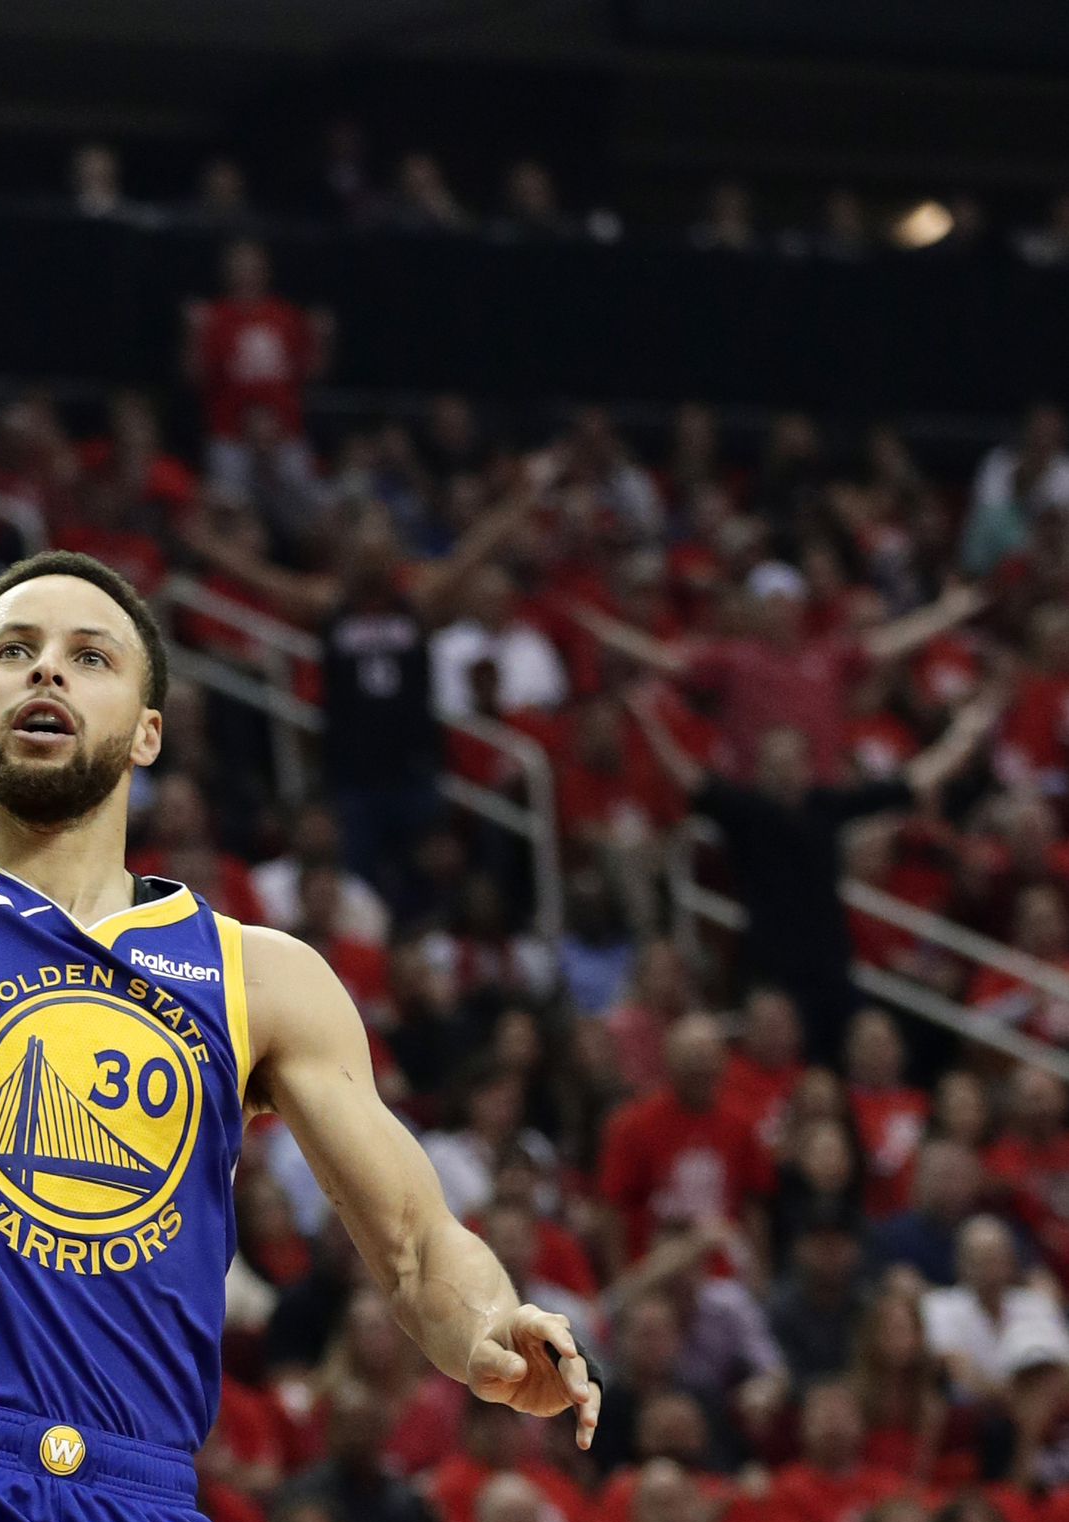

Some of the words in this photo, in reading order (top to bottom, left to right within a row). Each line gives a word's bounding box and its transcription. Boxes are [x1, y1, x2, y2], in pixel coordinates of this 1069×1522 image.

[130, 948, 220, 983] Rakuten
[126, 977, 210, 1064] STATE
[88, 1049, 178, 1118] 30
[46, 1435, 82, 1466] W
